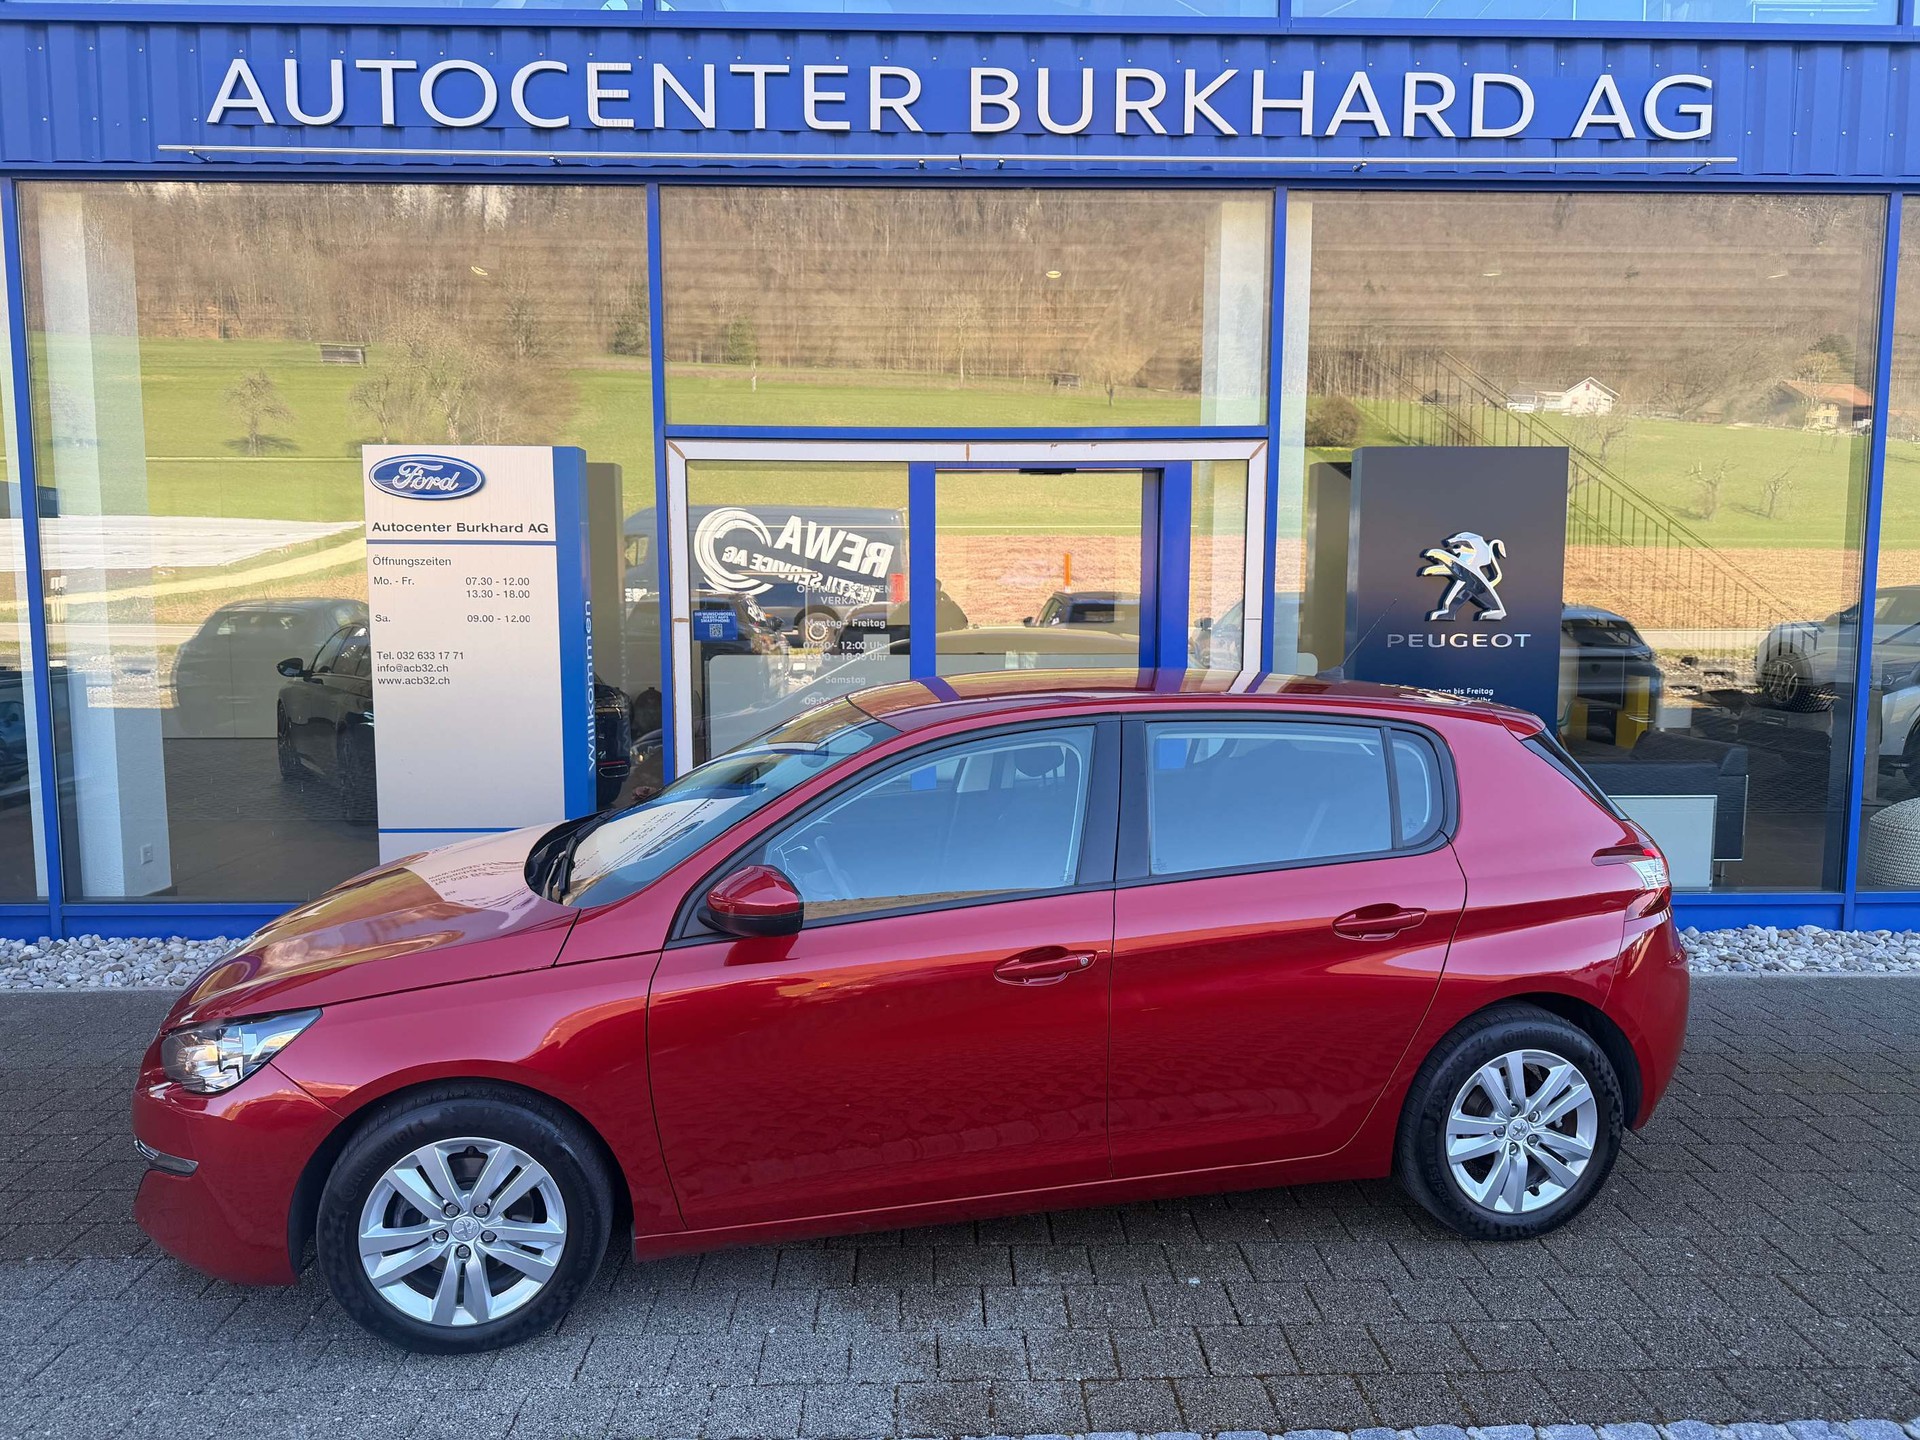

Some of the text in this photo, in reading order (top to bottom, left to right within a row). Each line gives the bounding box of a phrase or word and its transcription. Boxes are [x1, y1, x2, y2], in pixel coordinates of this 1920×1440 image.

[207, 58, 1713, 141] AUTOCENTER BURKHARD AG
[392, 462, 460, 491] Ford
[371, 522, 549, 533] Autocenter Burkhard AG
[372, 554, 452, 568] Öffnungszeiten
[373, 576, 393, 585] Mo.
[402, 576, 415, 585] Fr.
[465, 577, 493, 586] 07.30
[503, 577, 530, 586] 12.00
[466, 590, 493, 598] 13.30
[503, 590, 530, 598] 18.00
[375, 614, 391, 622] Sa.
[467, 614, 494, 623] 09.00
[505, 614, 531, 623] 12.00
[852, 619, 886, 629] Freitag
[840, 641, 866, 649] 12:00
[1387, 633, 1532, 648] PEUGEOT
[377, 651, 464, 660] Tel. 032 633 17 71
[870, 653, 887, 661] Uhr
[377, 663, 449, 673] info@acb32.ch
[378, 676, 450, 685] www.acb32.ch
[825, 676, 866, 685] Samstag
[585, 600, 595, 771] Willkommen
[1453, 687, 1464, 695] bis
[1466, 687, 1494, 696] Freitag
